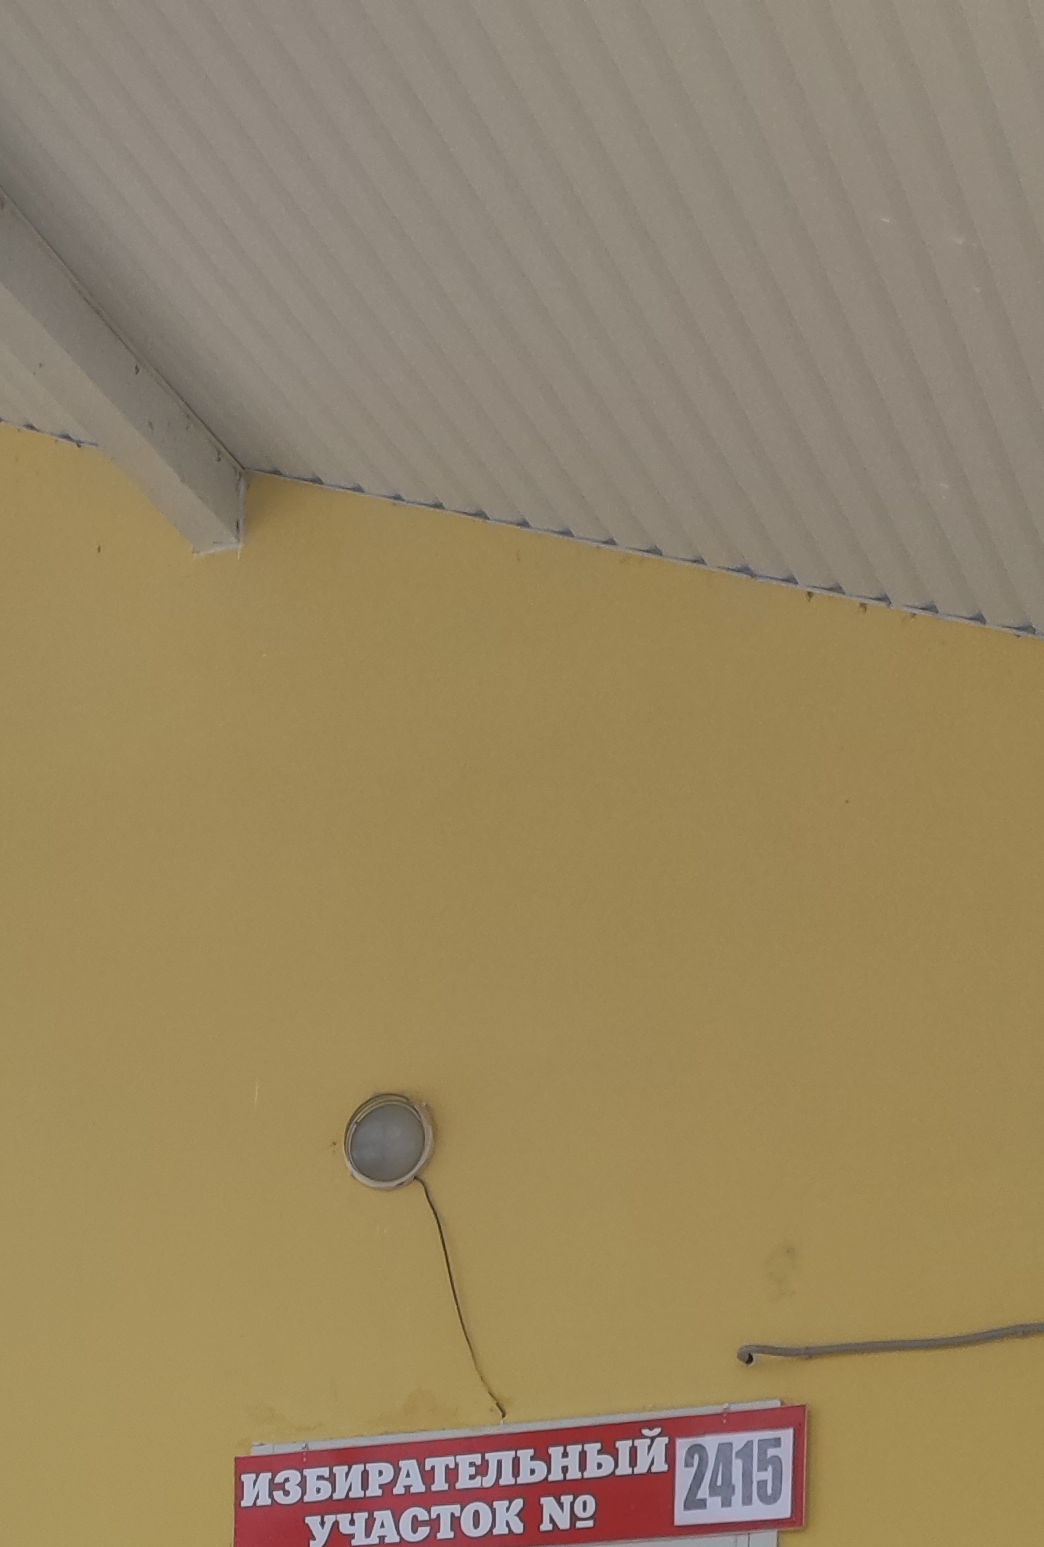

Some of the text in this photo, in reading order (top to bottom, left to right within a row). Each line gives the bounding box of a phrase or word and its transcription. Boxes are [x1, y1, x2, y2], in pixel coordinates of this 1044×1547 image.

[240, 1427, 670, 1508] ИЗБИРАТЕЛЬНЫЙ
[682, 1436, 784, 1512] 2415
[539, 1494, 597, 1532] №
